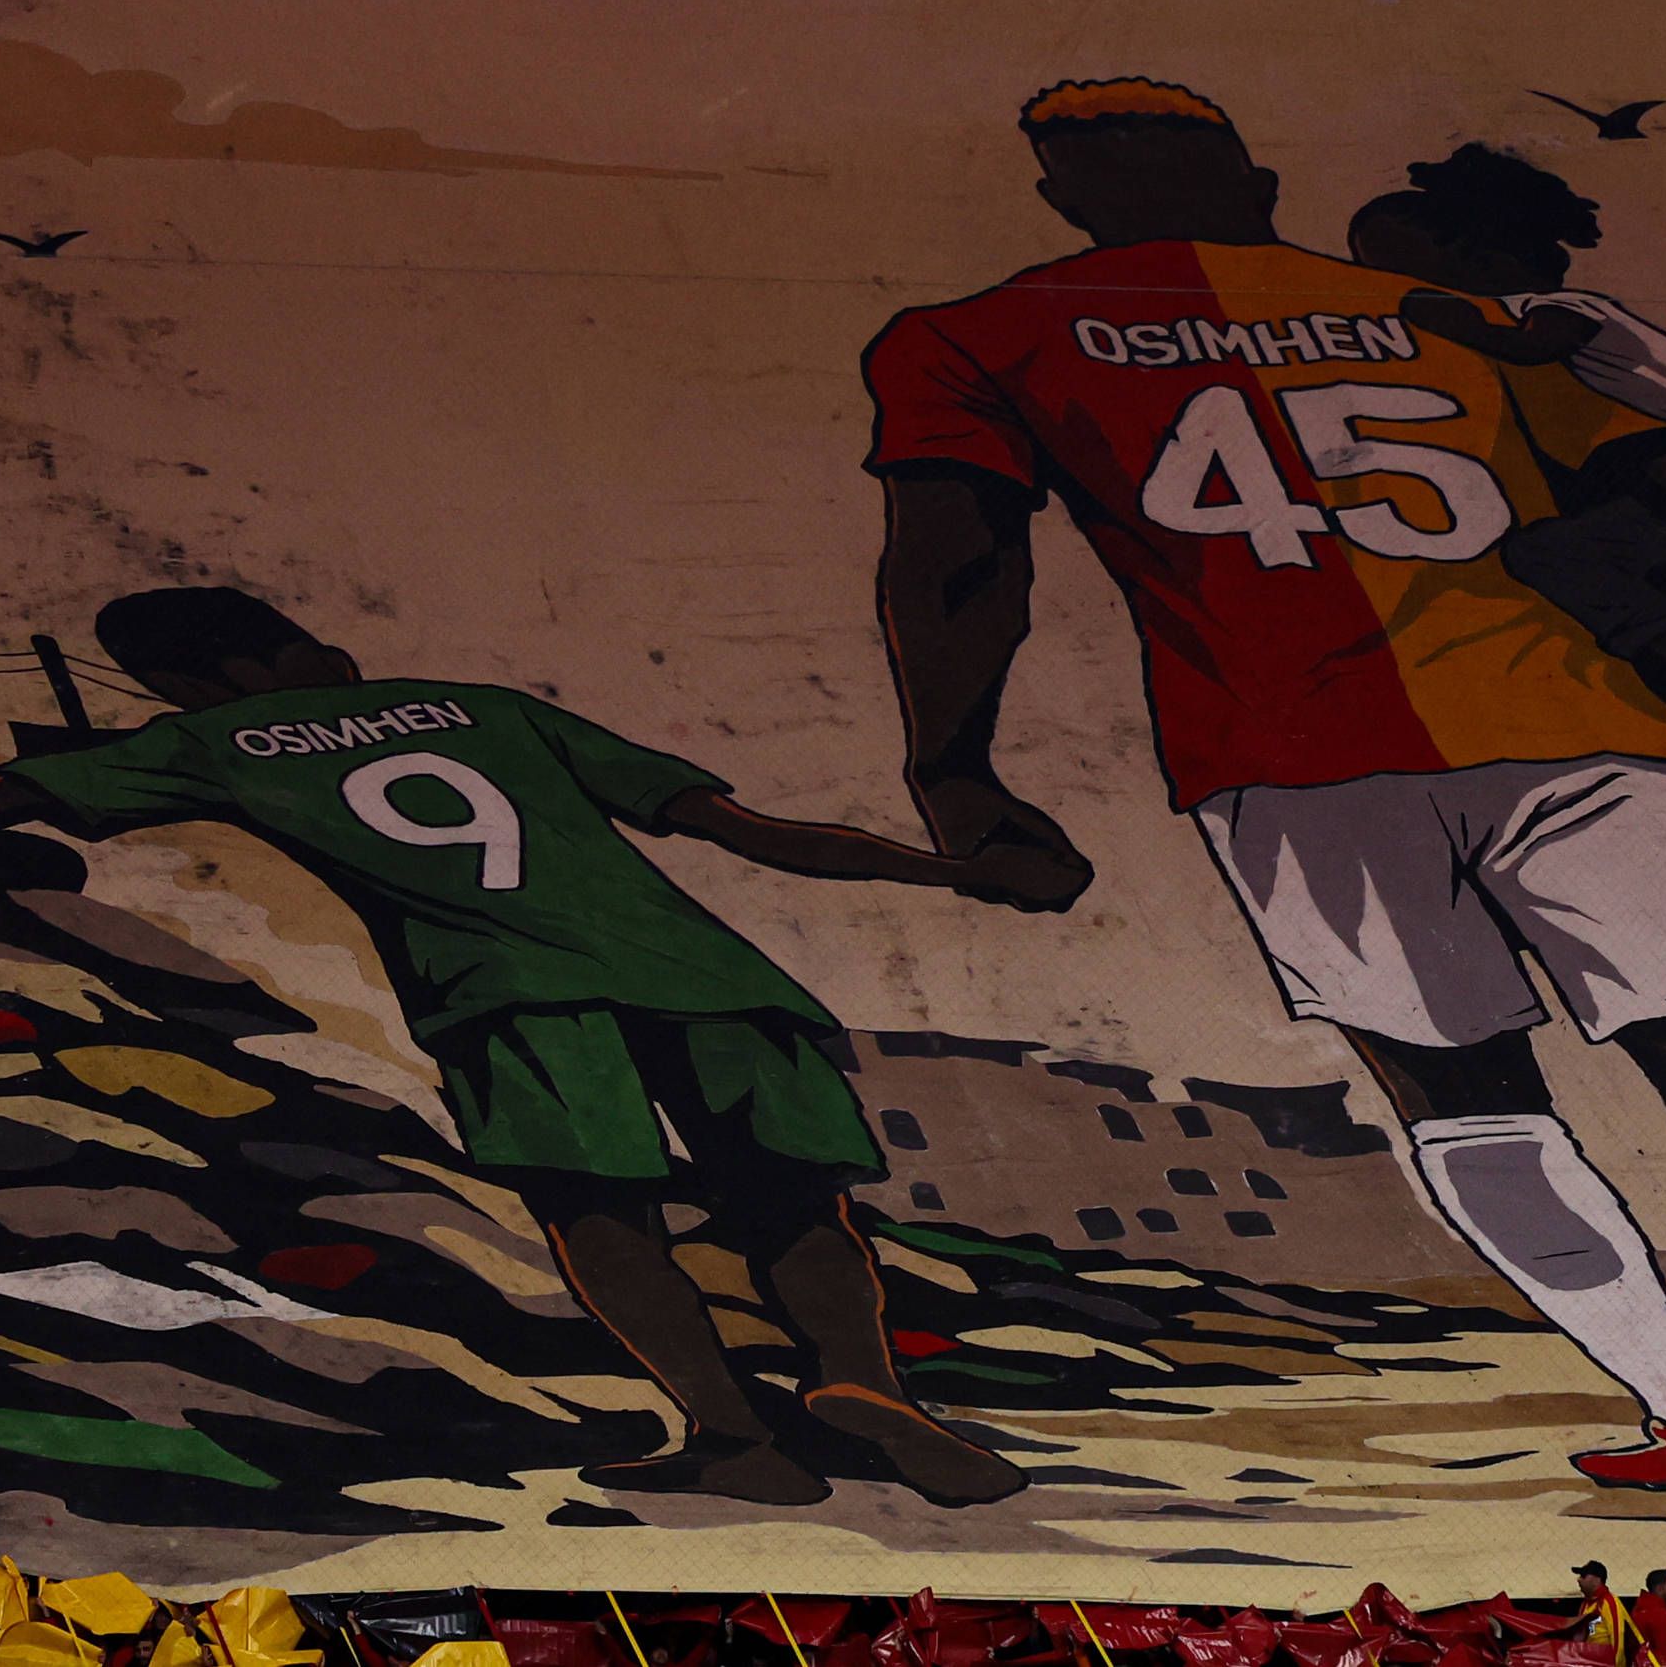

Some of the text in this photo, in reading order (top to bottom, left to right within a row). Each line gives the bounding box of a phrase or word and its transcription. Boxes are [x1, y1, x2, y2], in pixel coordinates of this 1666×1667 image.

[1073, 313, 1416, 367] OSIMHEN
[1140, 382, 1513, 569] 45
[234, 699, 473, 758] OSIMHEN
[341, 750, 522, 891] 9
